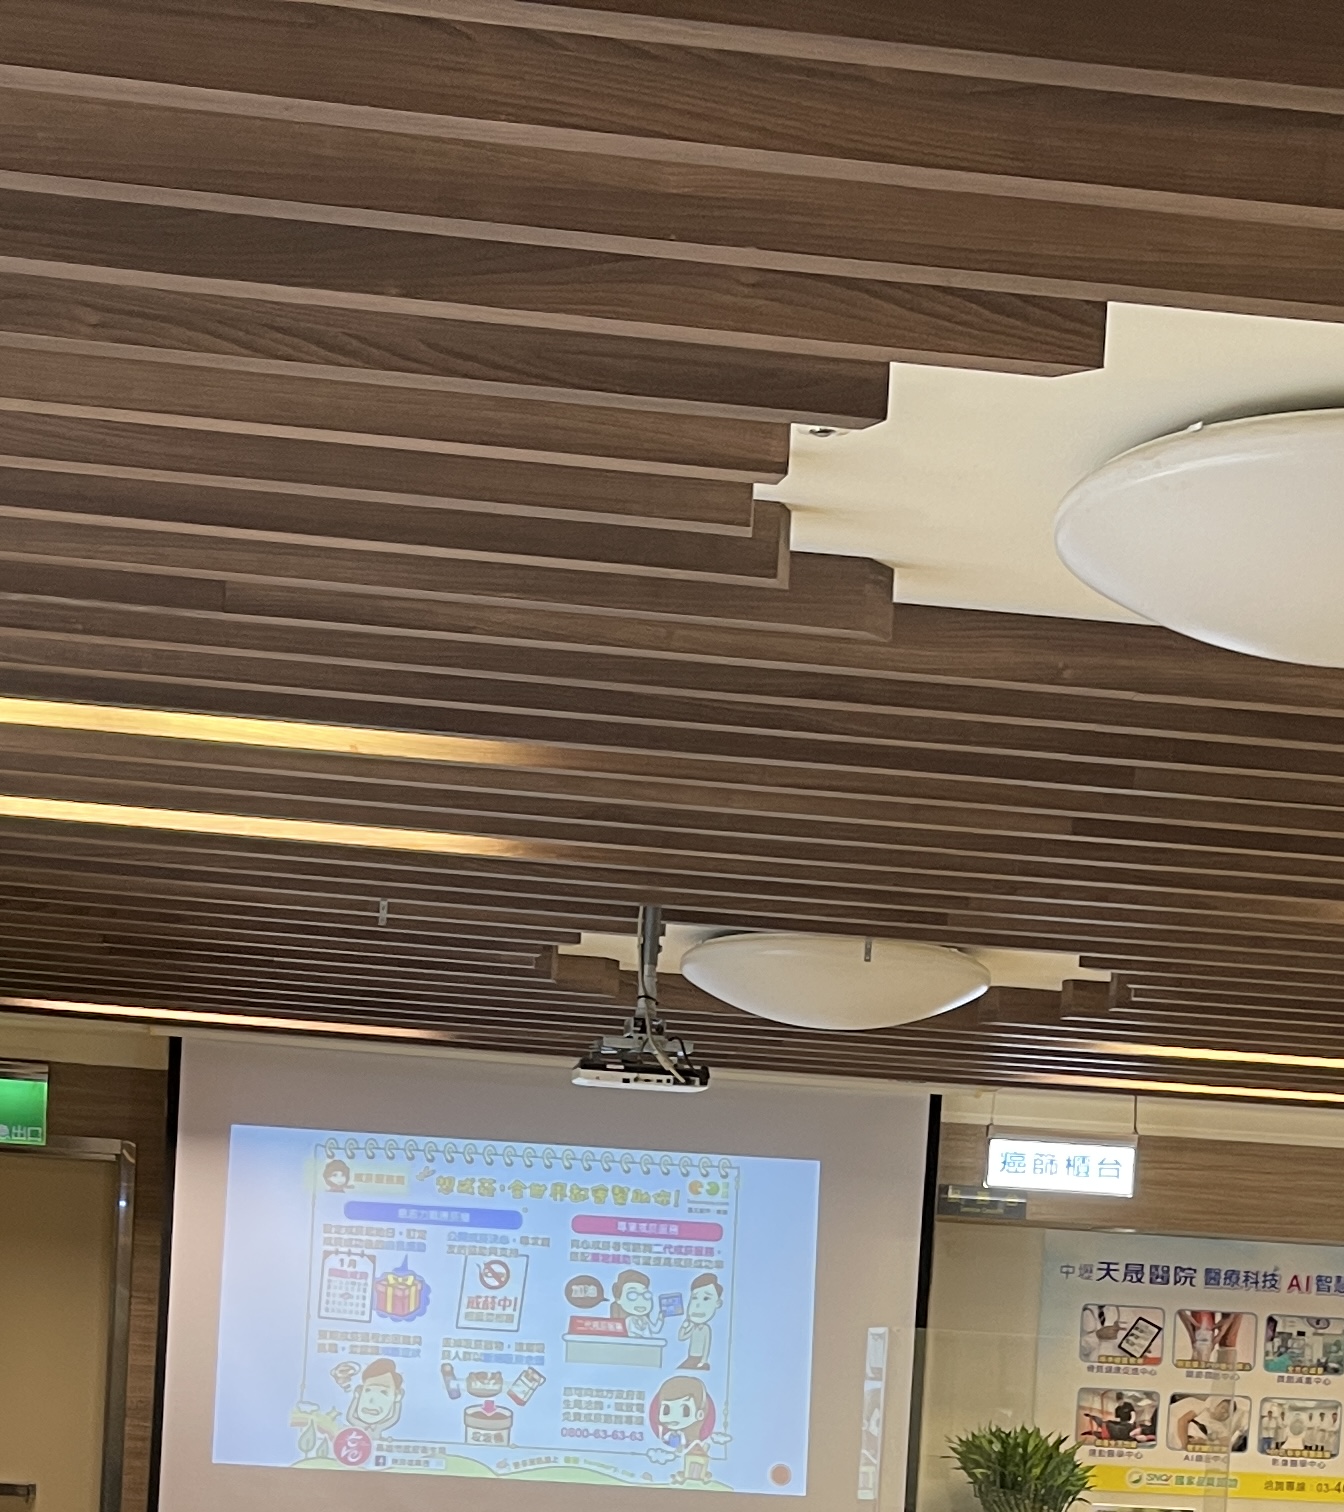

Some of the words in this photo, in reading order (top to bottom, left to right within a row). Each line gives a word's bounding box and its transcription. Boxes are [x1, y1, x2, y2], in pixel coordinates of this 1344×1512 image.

[1000, 1152, 1122, 1179] 癌篩櫃台
[1059, 1261, 1197, 1287] 中壢天晟醫院
[1204, 1267, 1280, 1291] 醫療科技
[561, 1427, 644, 1441] 0800-63-63-63
